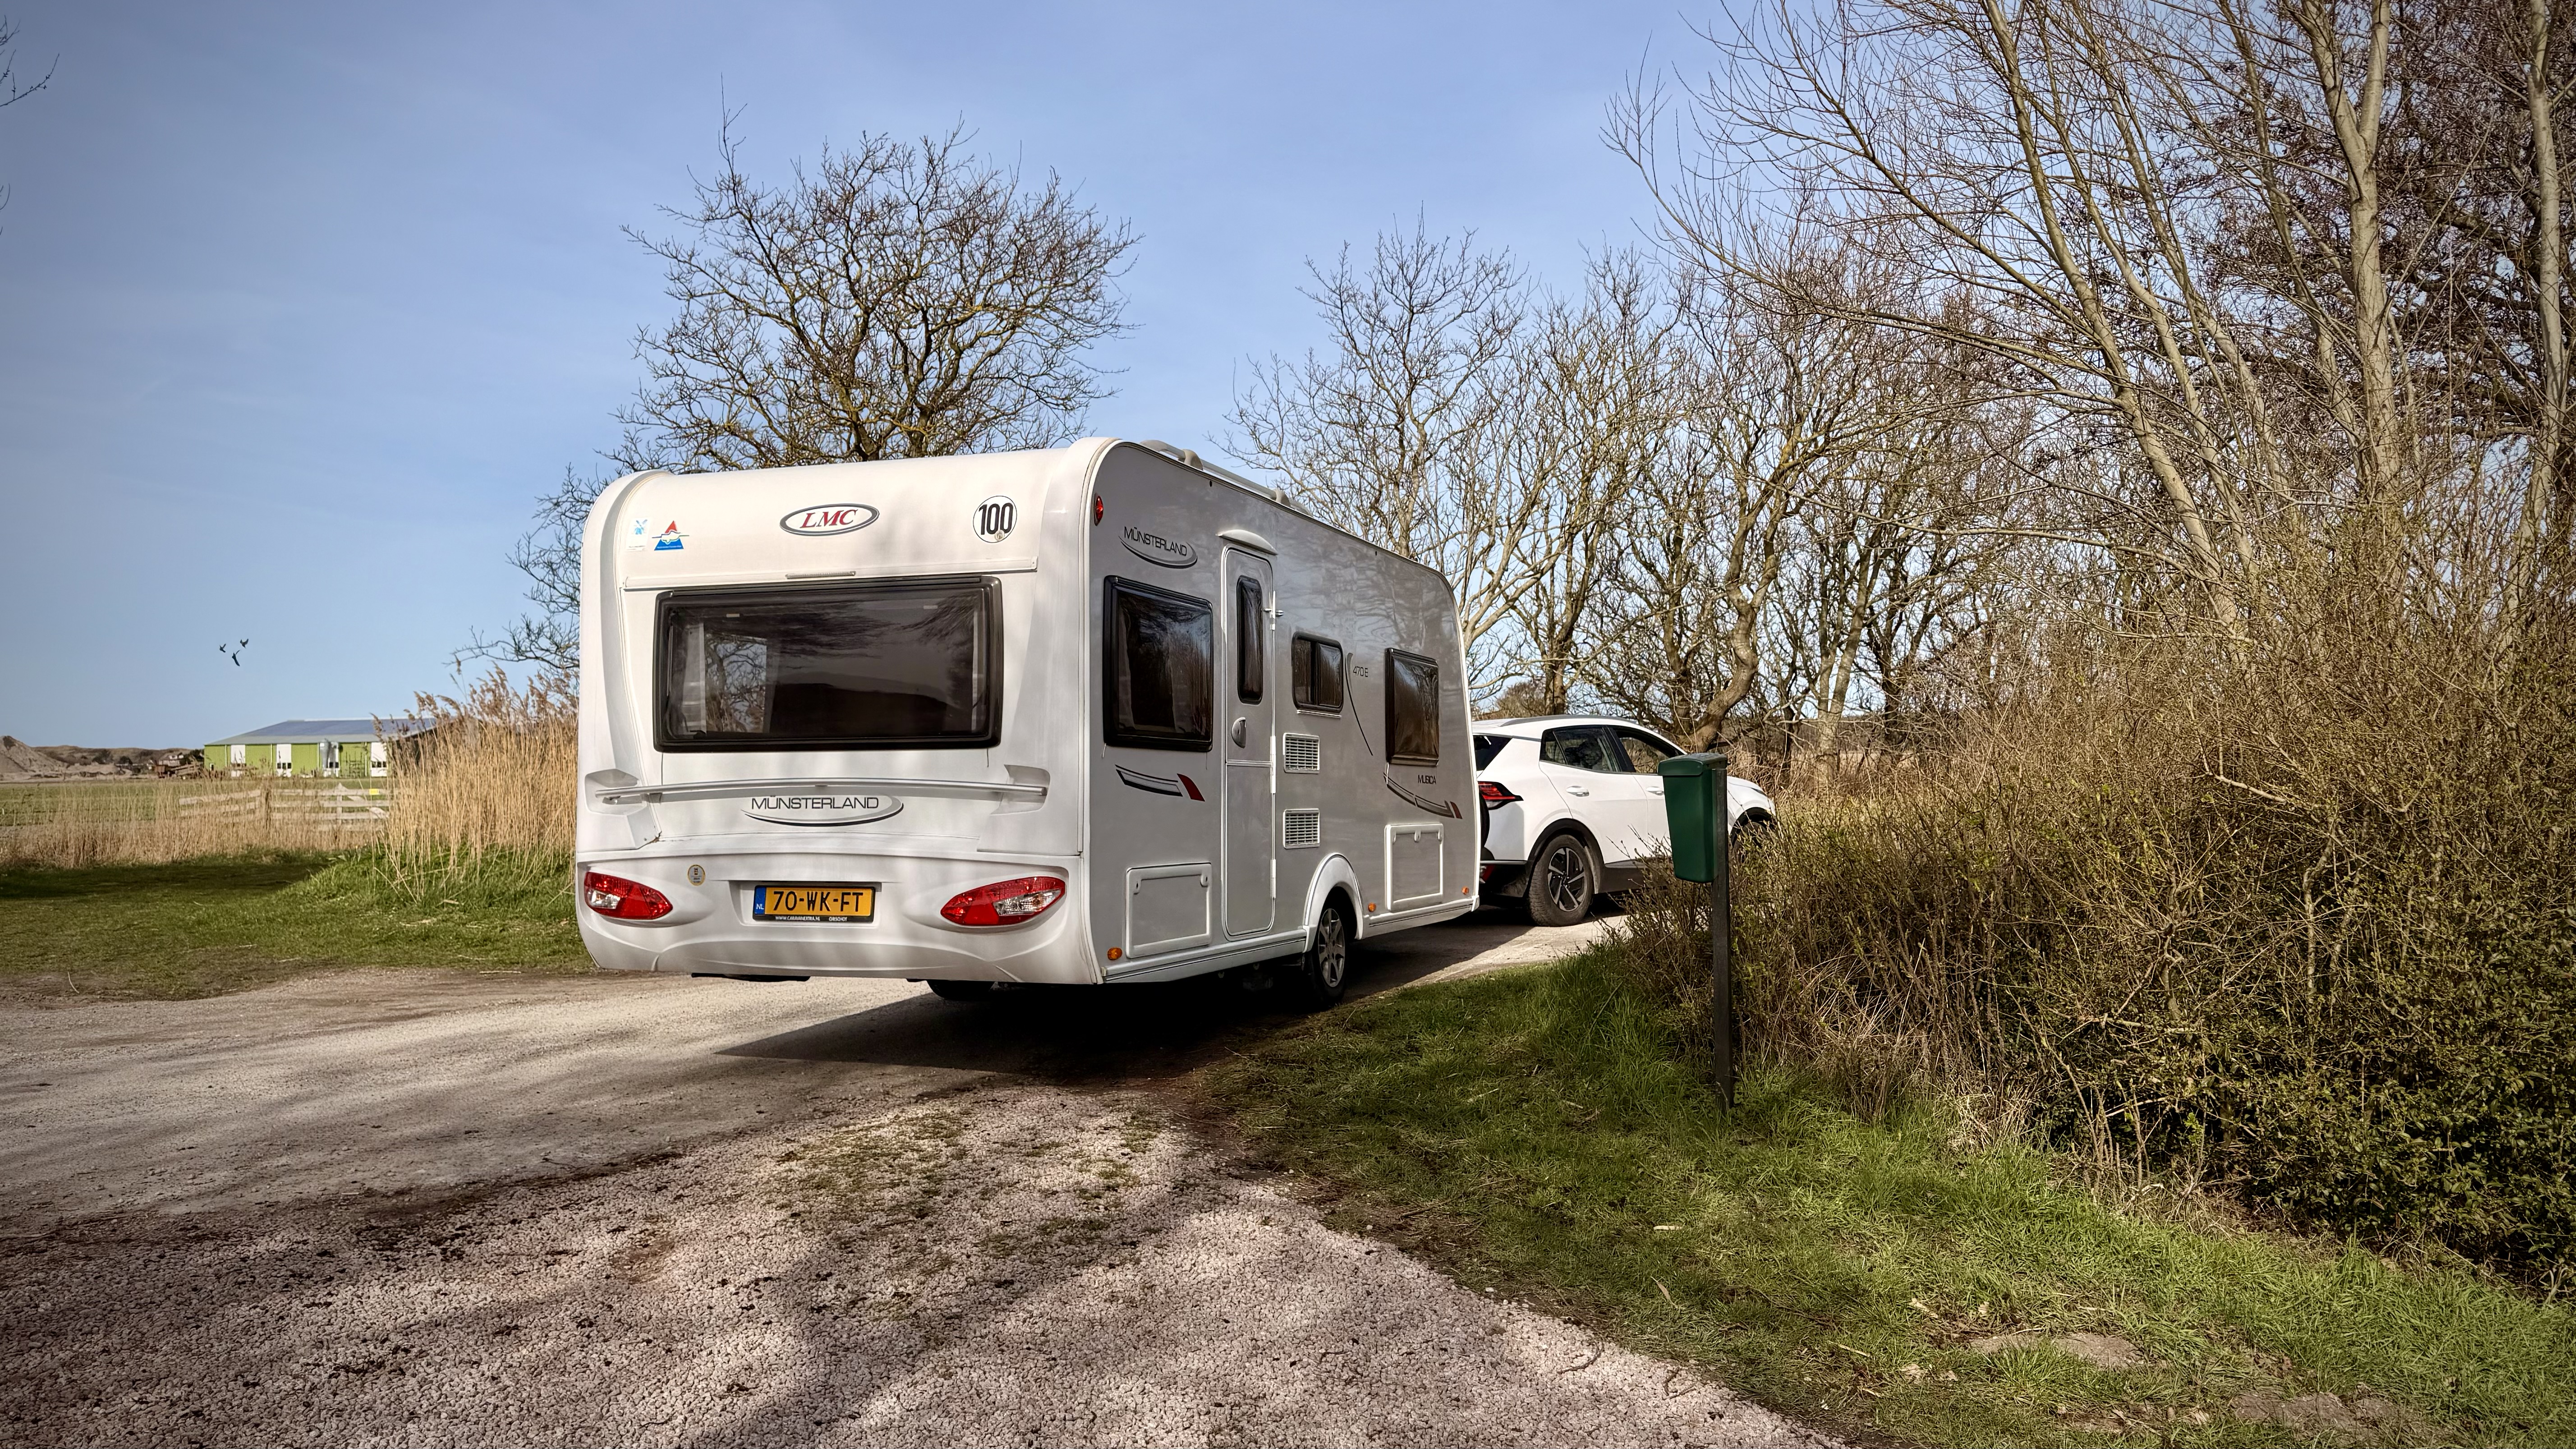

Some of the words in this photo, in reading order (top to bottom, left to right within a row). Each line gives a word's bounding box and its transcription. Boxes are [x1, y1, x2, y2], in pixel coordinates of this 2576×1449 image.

[800, 509, 859, 529] LMC
[978, 502, 1013, 535] 100
[1124, 526, 1187, 556] MÜNSTERLAND
[751, 795, 879, 810] MÜNSTERLAND
[773, 891, 864, 912] 70-WK-FT
